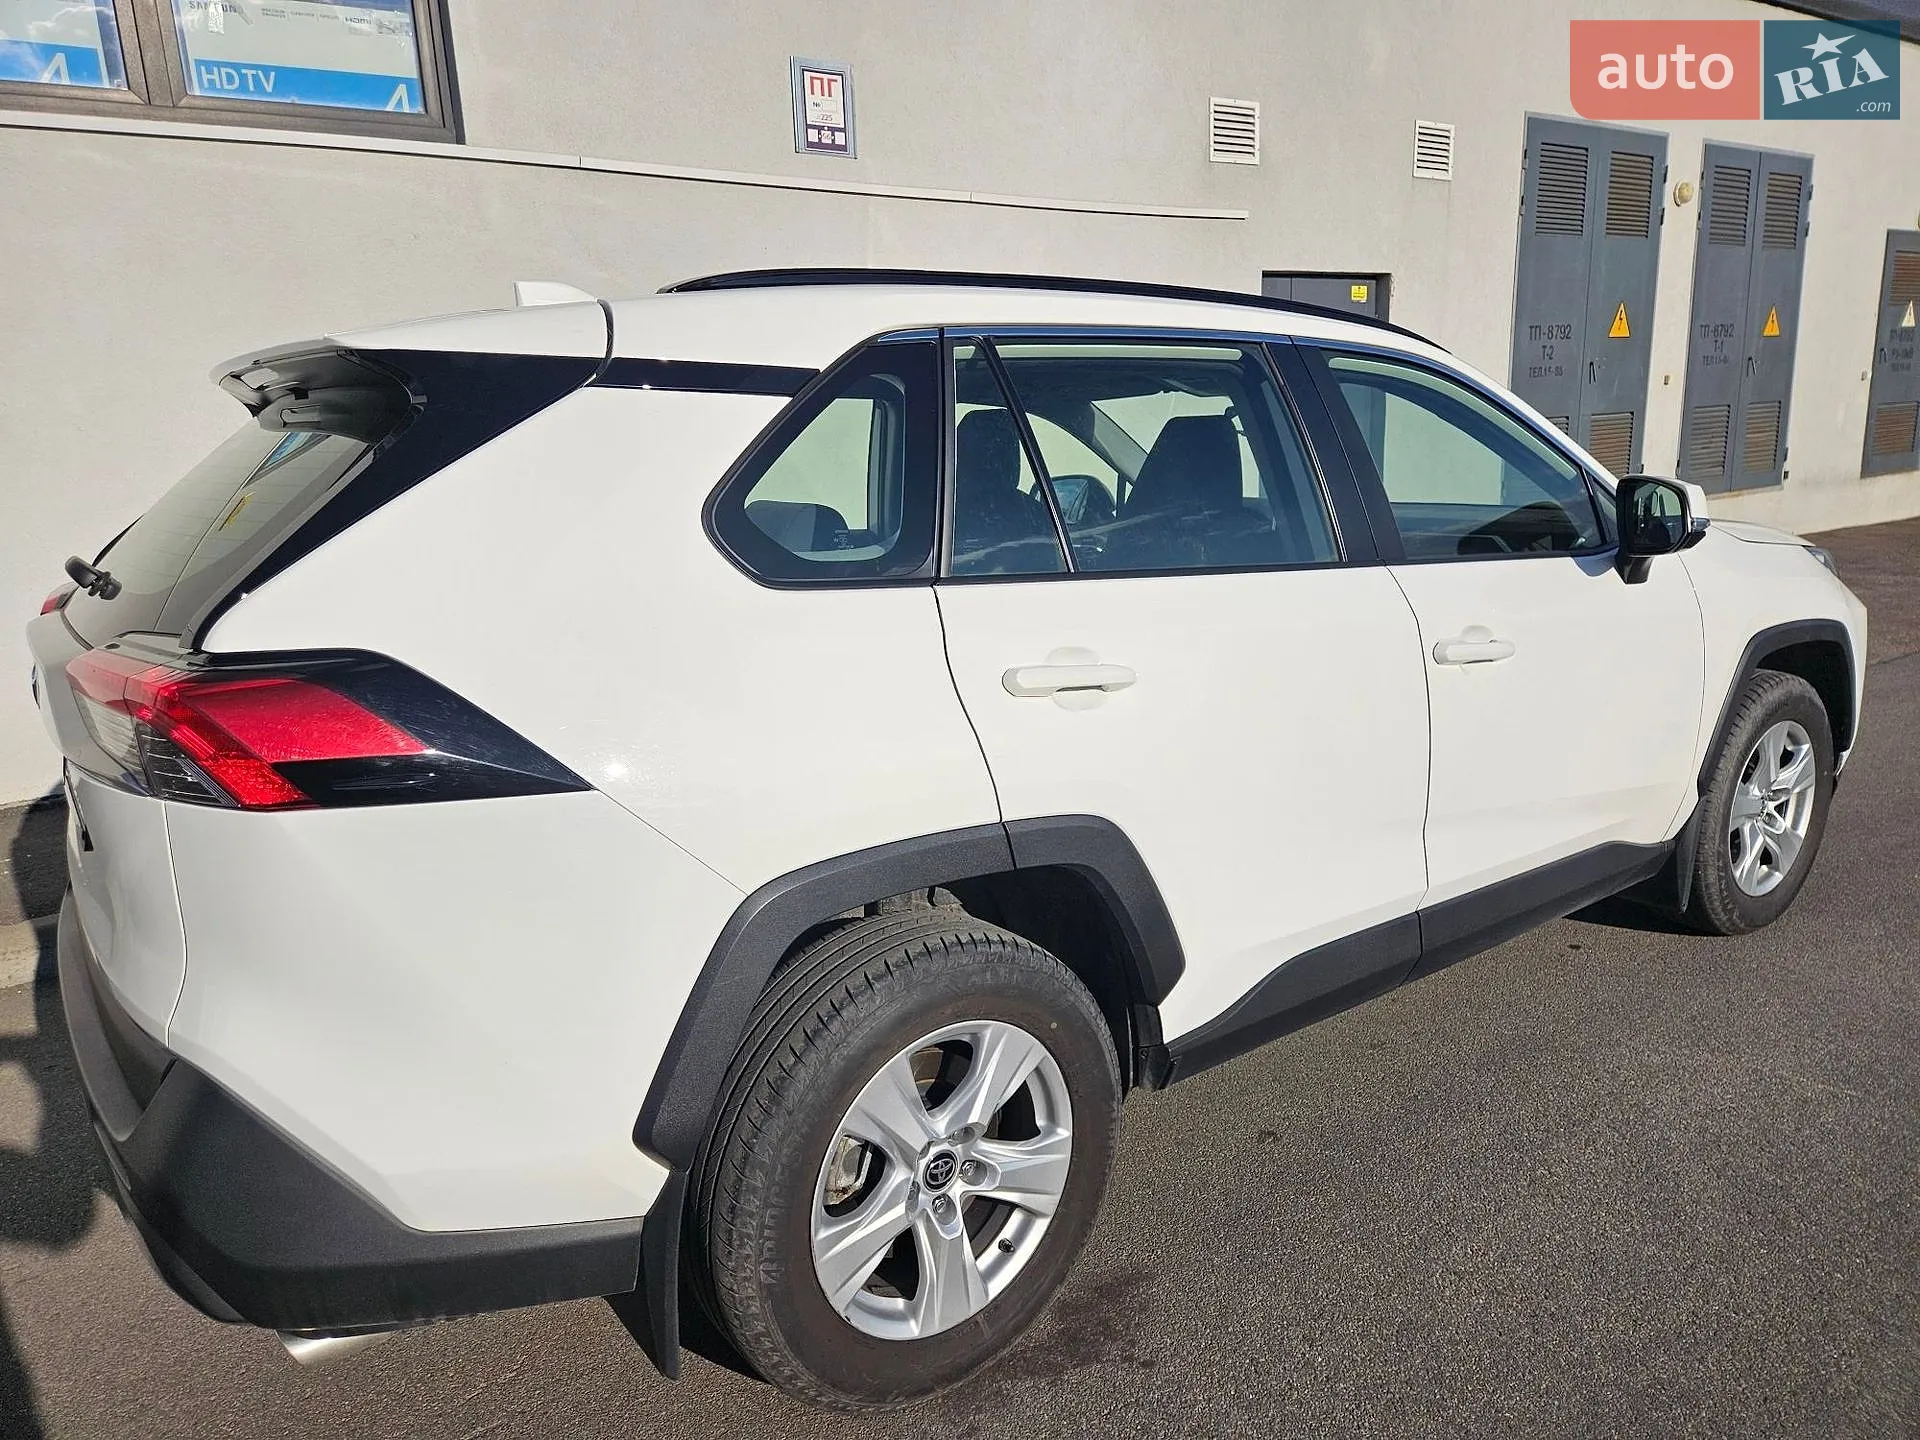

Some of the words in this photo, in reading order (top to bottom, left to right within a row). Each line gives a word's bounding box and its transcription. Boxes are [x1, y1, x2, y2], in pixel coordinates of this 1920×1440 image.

[201, 65, 276, 93] HDTV
[809, 75, 838, 97] ПГ
[1529, 323, 1572, 341] ТП-8792
